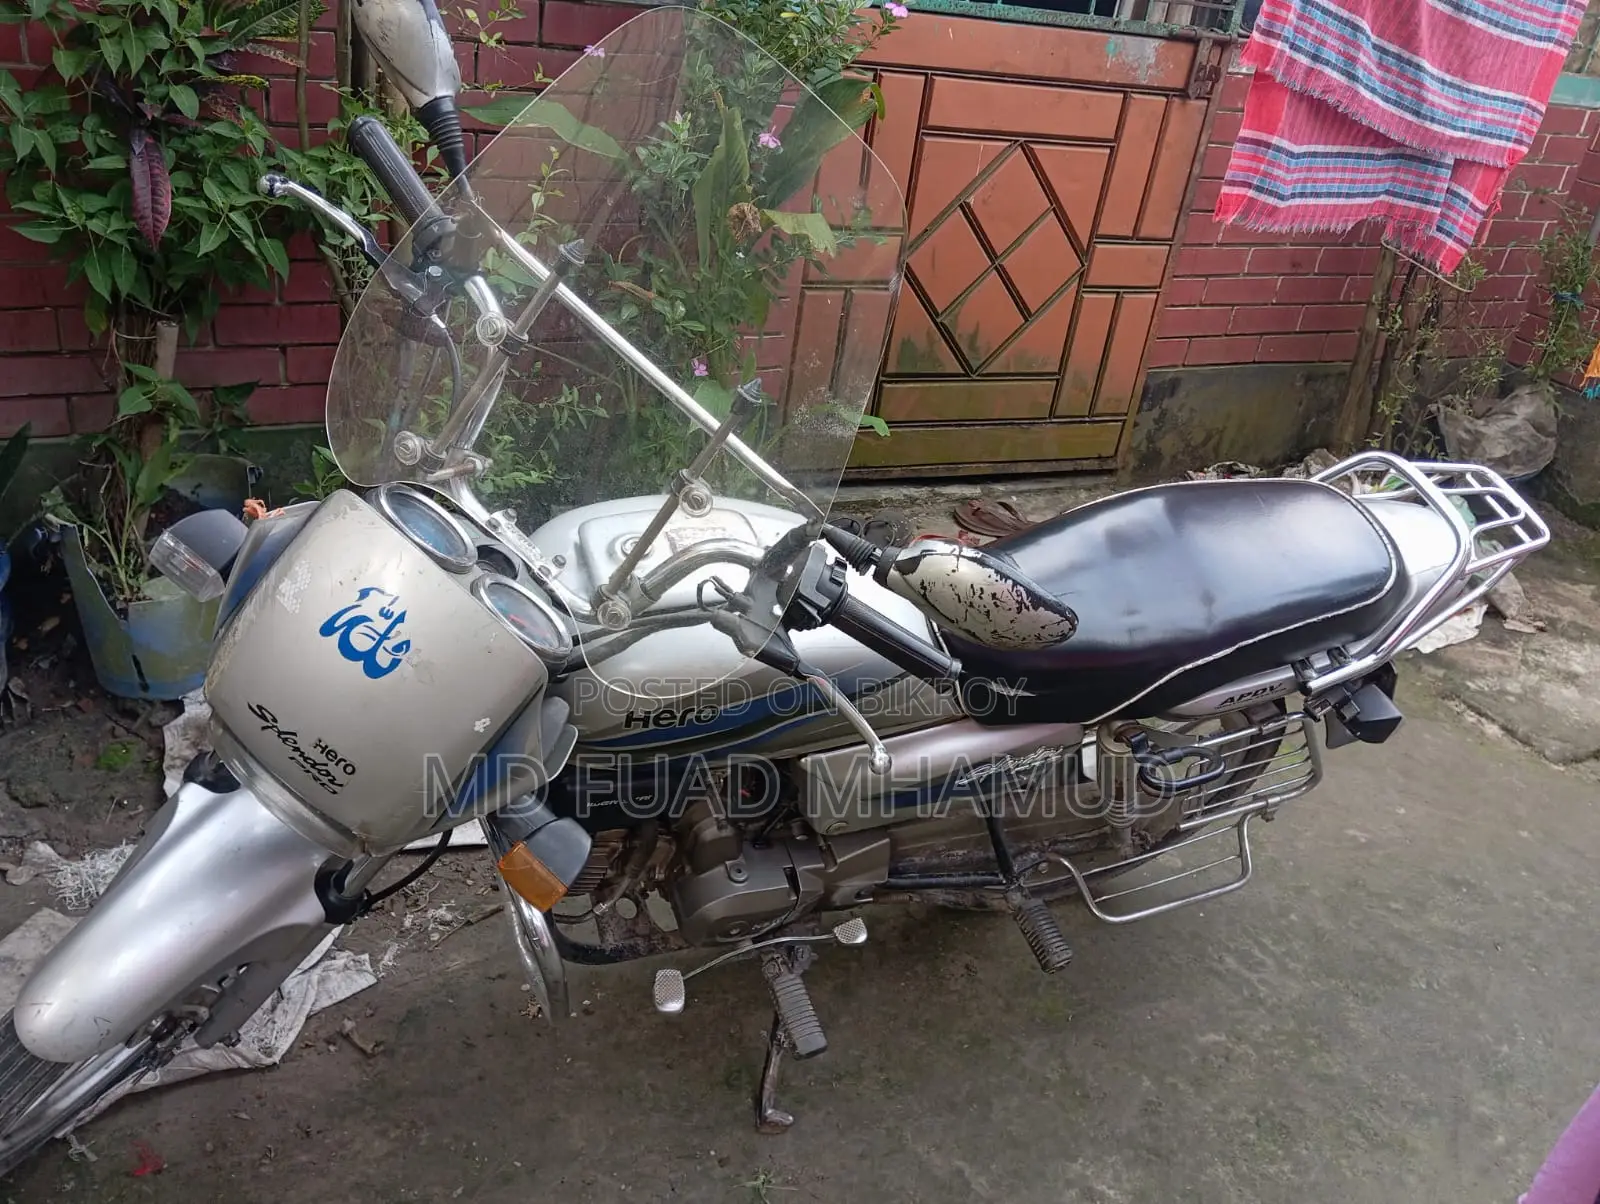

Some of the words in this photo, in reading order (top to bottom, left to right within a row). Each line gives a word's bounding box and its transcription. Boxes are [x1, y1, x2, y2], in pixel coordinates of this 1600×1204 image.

[624, 704, 721, 729] Hero
[247, 701, 344, 788] Splendor
[312, 737, 356, 776] Hero
